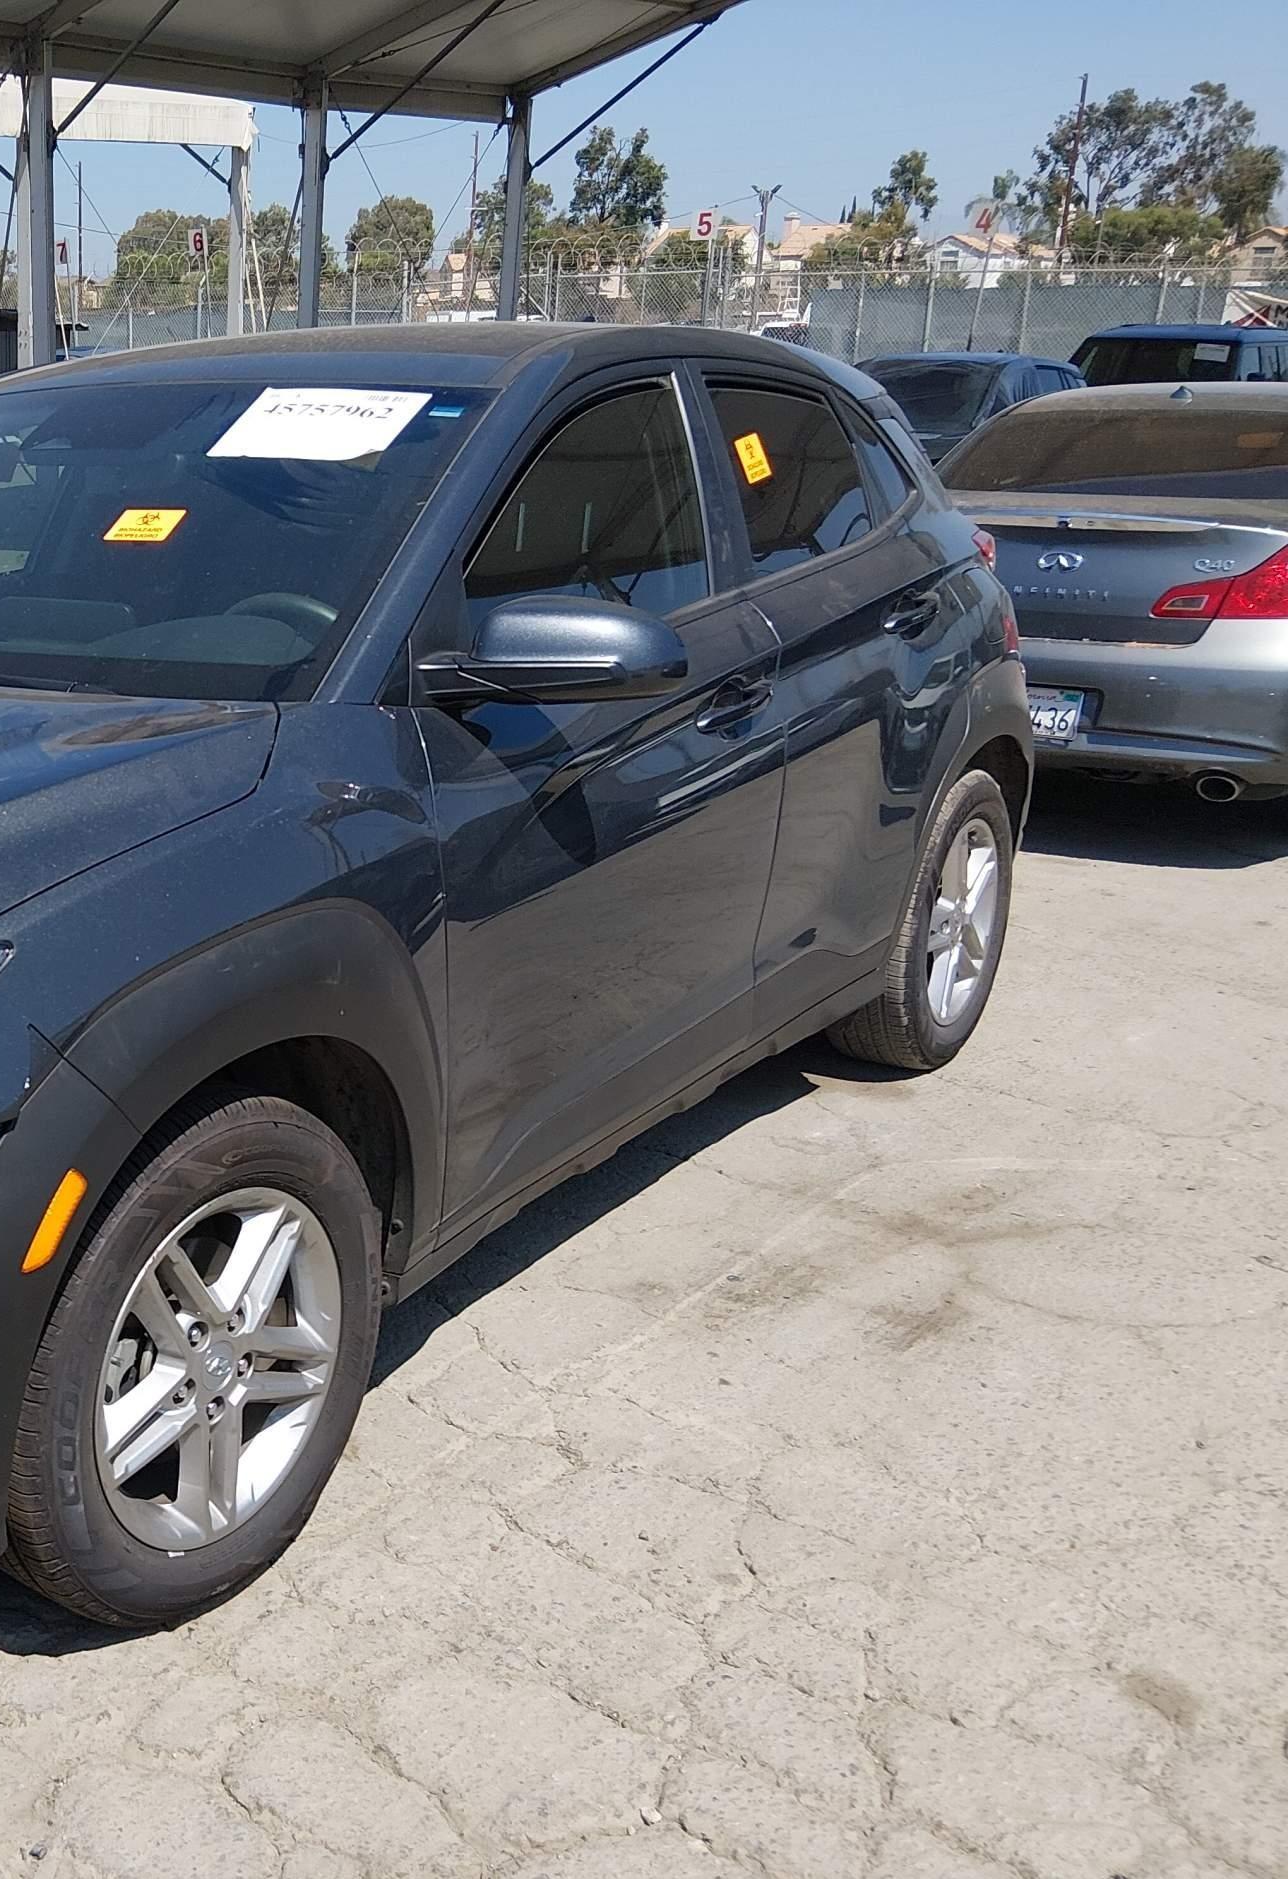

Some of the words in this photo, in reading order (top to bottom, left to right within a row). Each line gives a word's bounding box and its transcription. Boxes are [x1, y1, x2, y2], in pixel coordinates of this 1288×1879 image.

[697, 212, 712, 237] 5
[976, 208, 991, 234] 4
[193, 232, 203, 251] 6
[56, 242, 66, 262] 7
[1194, 558, 1236, 573] Q40
[1013, 585, 1110, 598] NFINITI
[1029, 705, 1073, 731] 436
